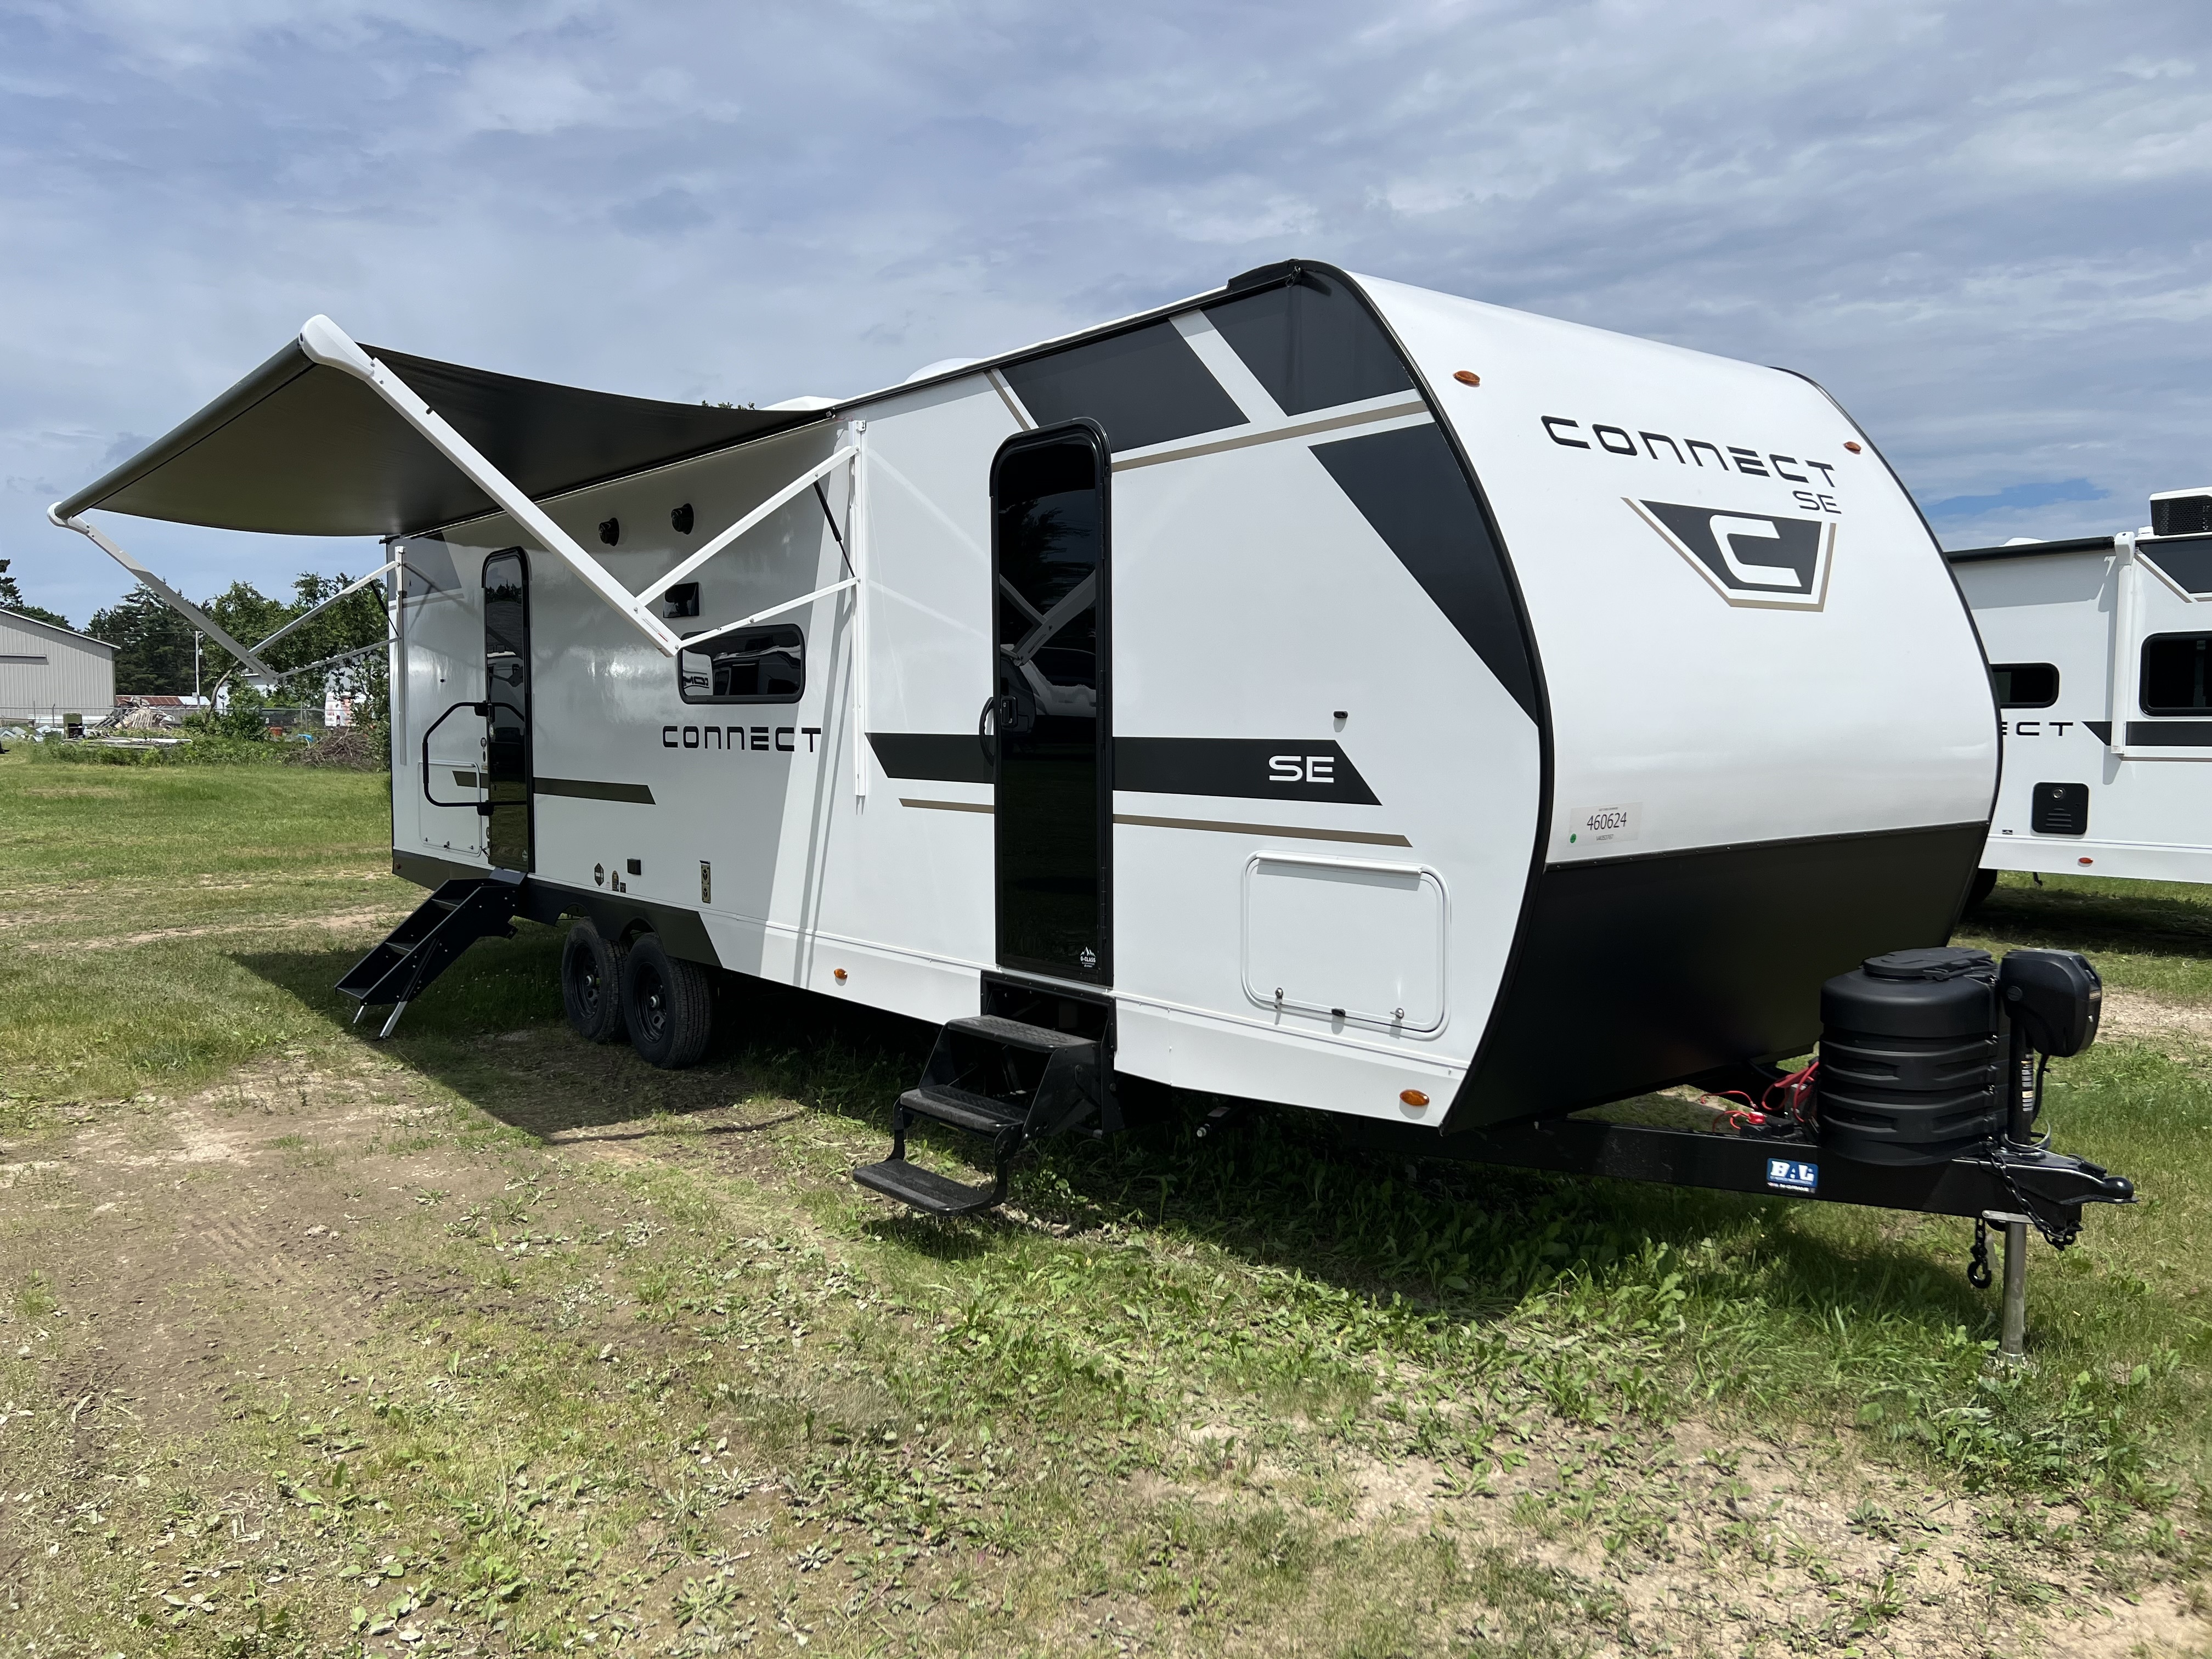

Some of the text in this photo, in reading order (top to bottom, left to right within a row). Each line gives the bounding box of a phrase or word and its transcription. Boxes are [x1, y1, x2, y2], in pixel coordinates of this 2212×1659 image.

[1541, 415, 1836, 488] CONNECT
[1792, 490, 1842, 515] SE
[663, 726, 822, 753] CONNECT
[2001, 721, 2073, 736] CT
[1268, 755, 1334, 783] SE
[1587, 812, 1627, 831] 460624
